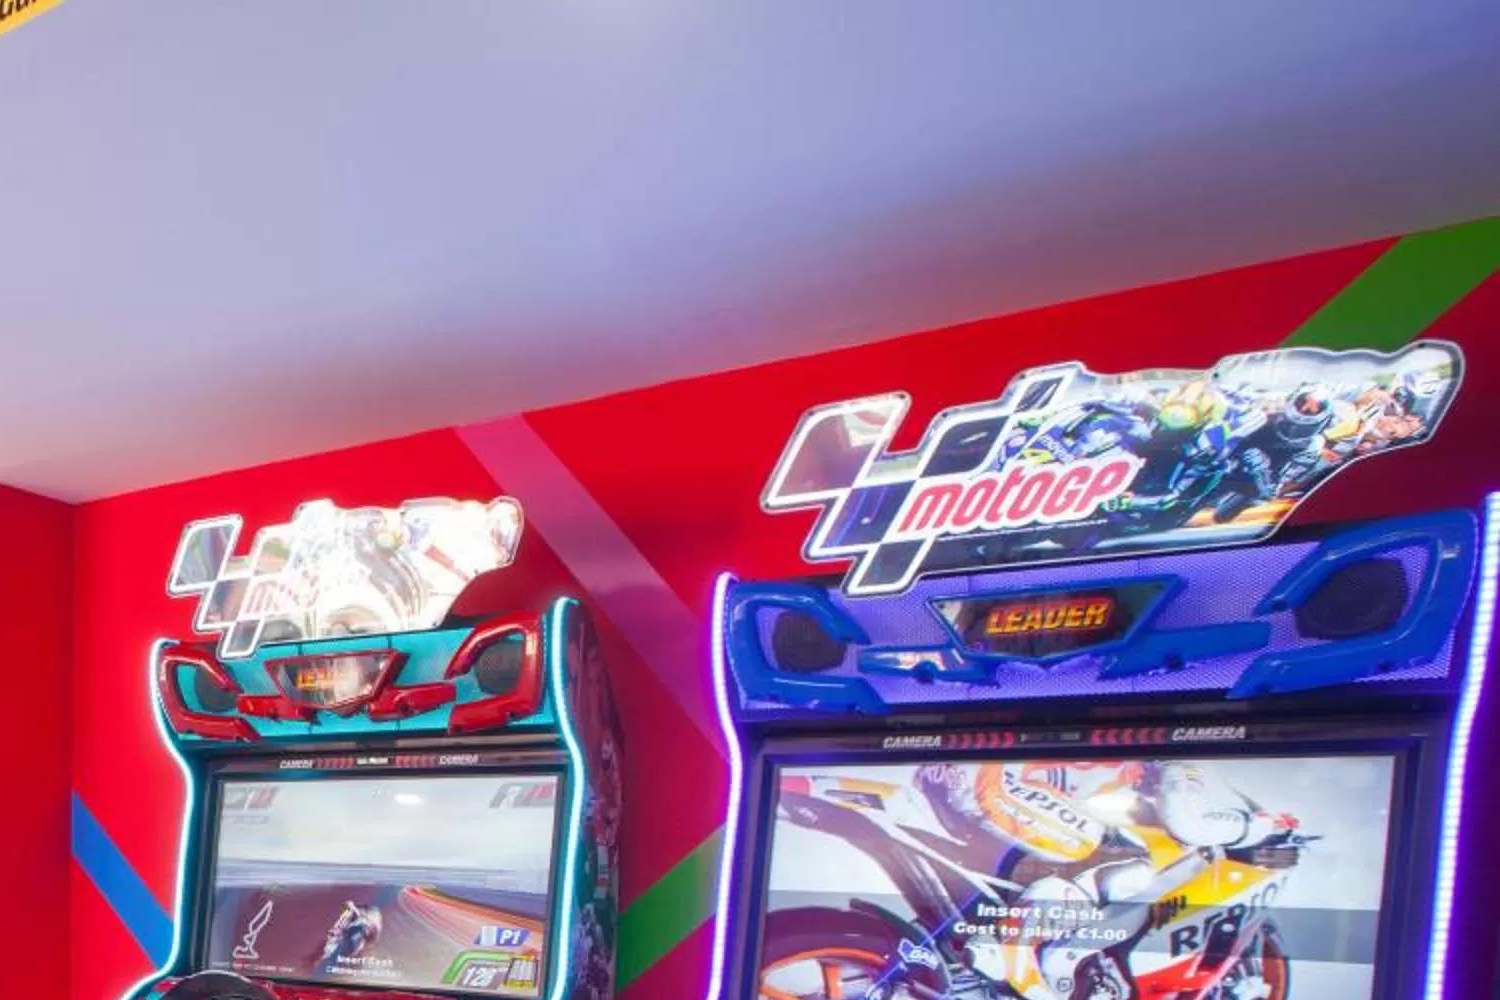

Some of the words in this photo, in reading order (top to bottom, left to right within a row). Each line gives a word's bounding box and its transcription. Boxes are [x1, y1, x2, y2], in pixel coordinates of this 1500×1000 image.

[985, 600, 1113, 636] LEADER
[1171, 725, 1246, 742] CAMERA
[882, 735, 942, 750] CAMERA
[279, 758, 315, 769] CAMERA
[976, 903, 1043, 919] Insert
[1049, 905, 1106, 921] Cash
[499, 929, 521, 945] P1
[953, 922, 997, 936] Cost
[1000, 924, 1021, 937] to
